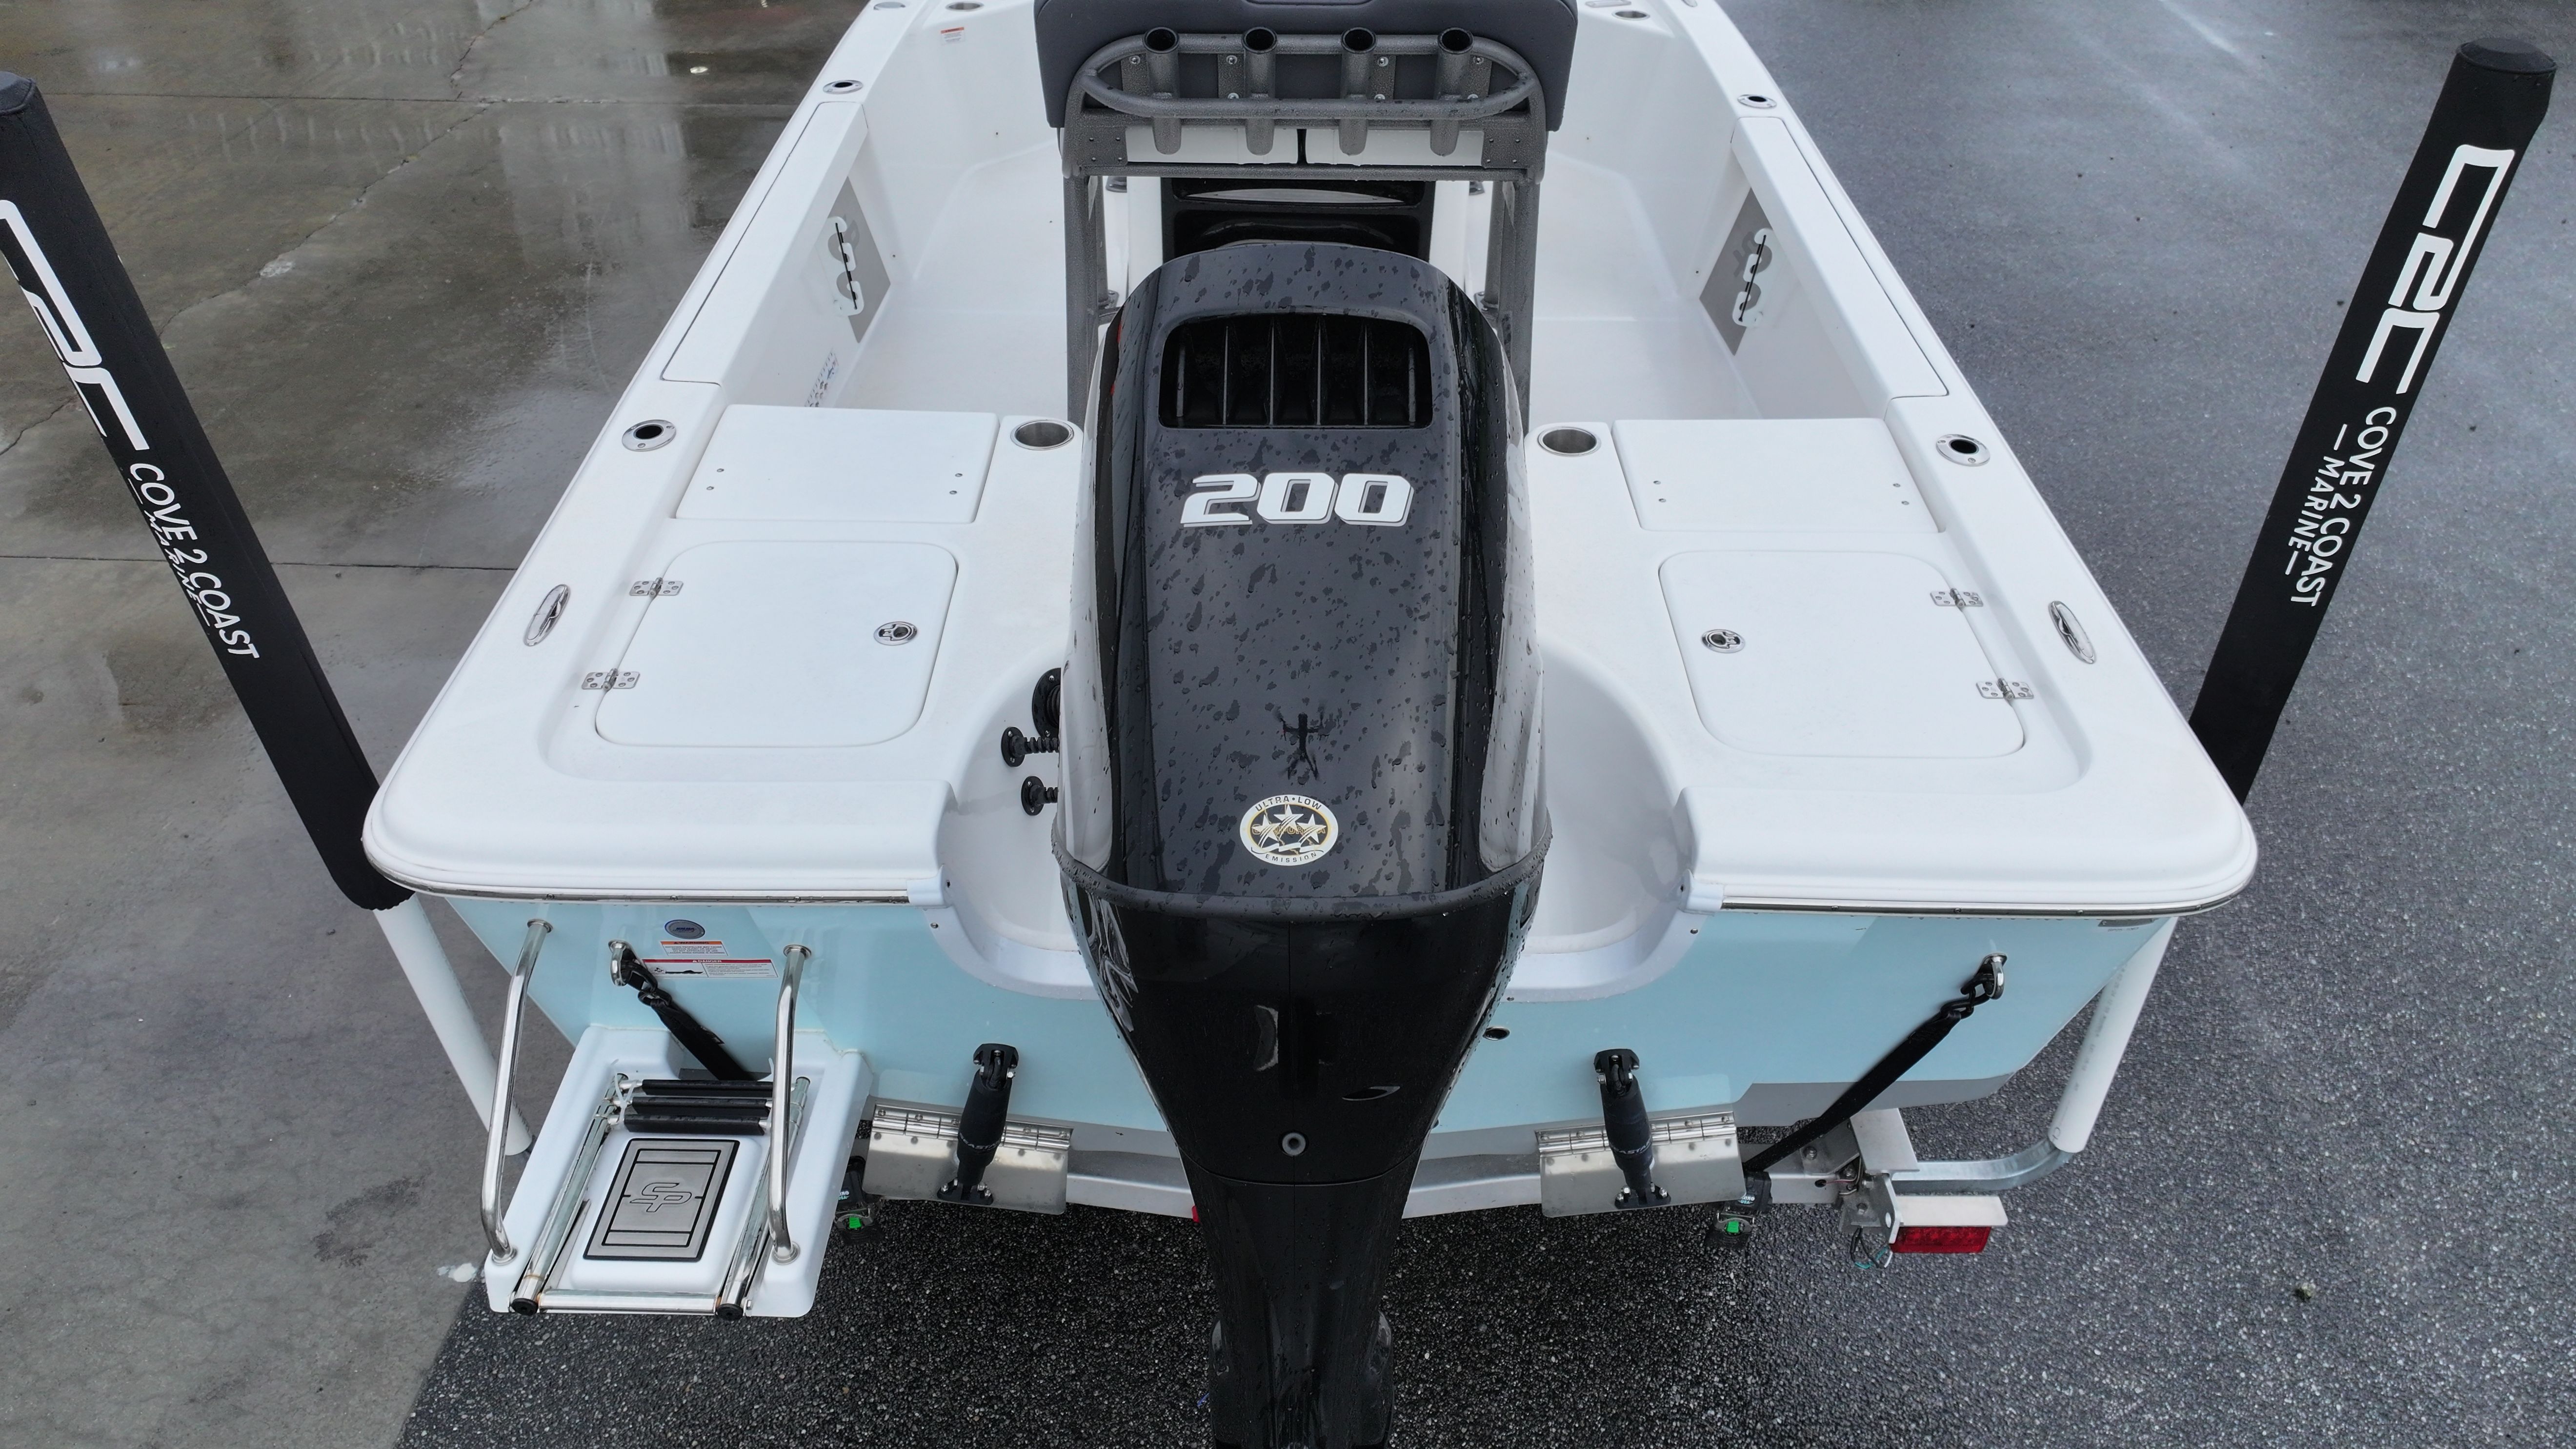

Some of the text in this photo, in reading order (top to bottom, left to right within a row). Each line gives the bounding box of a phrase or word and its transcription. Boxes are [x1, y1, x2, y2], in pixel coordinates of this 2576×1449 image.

[1180, 472, 1414, 527] 200
[2288, 456, 2345, 552] MARINE
[2291, 407, 2396, 606] COVE 2 COAST
[130, 463, 260, 658] COVE 2 COAST
[1265, 852, 1317, 863] EMISSION
